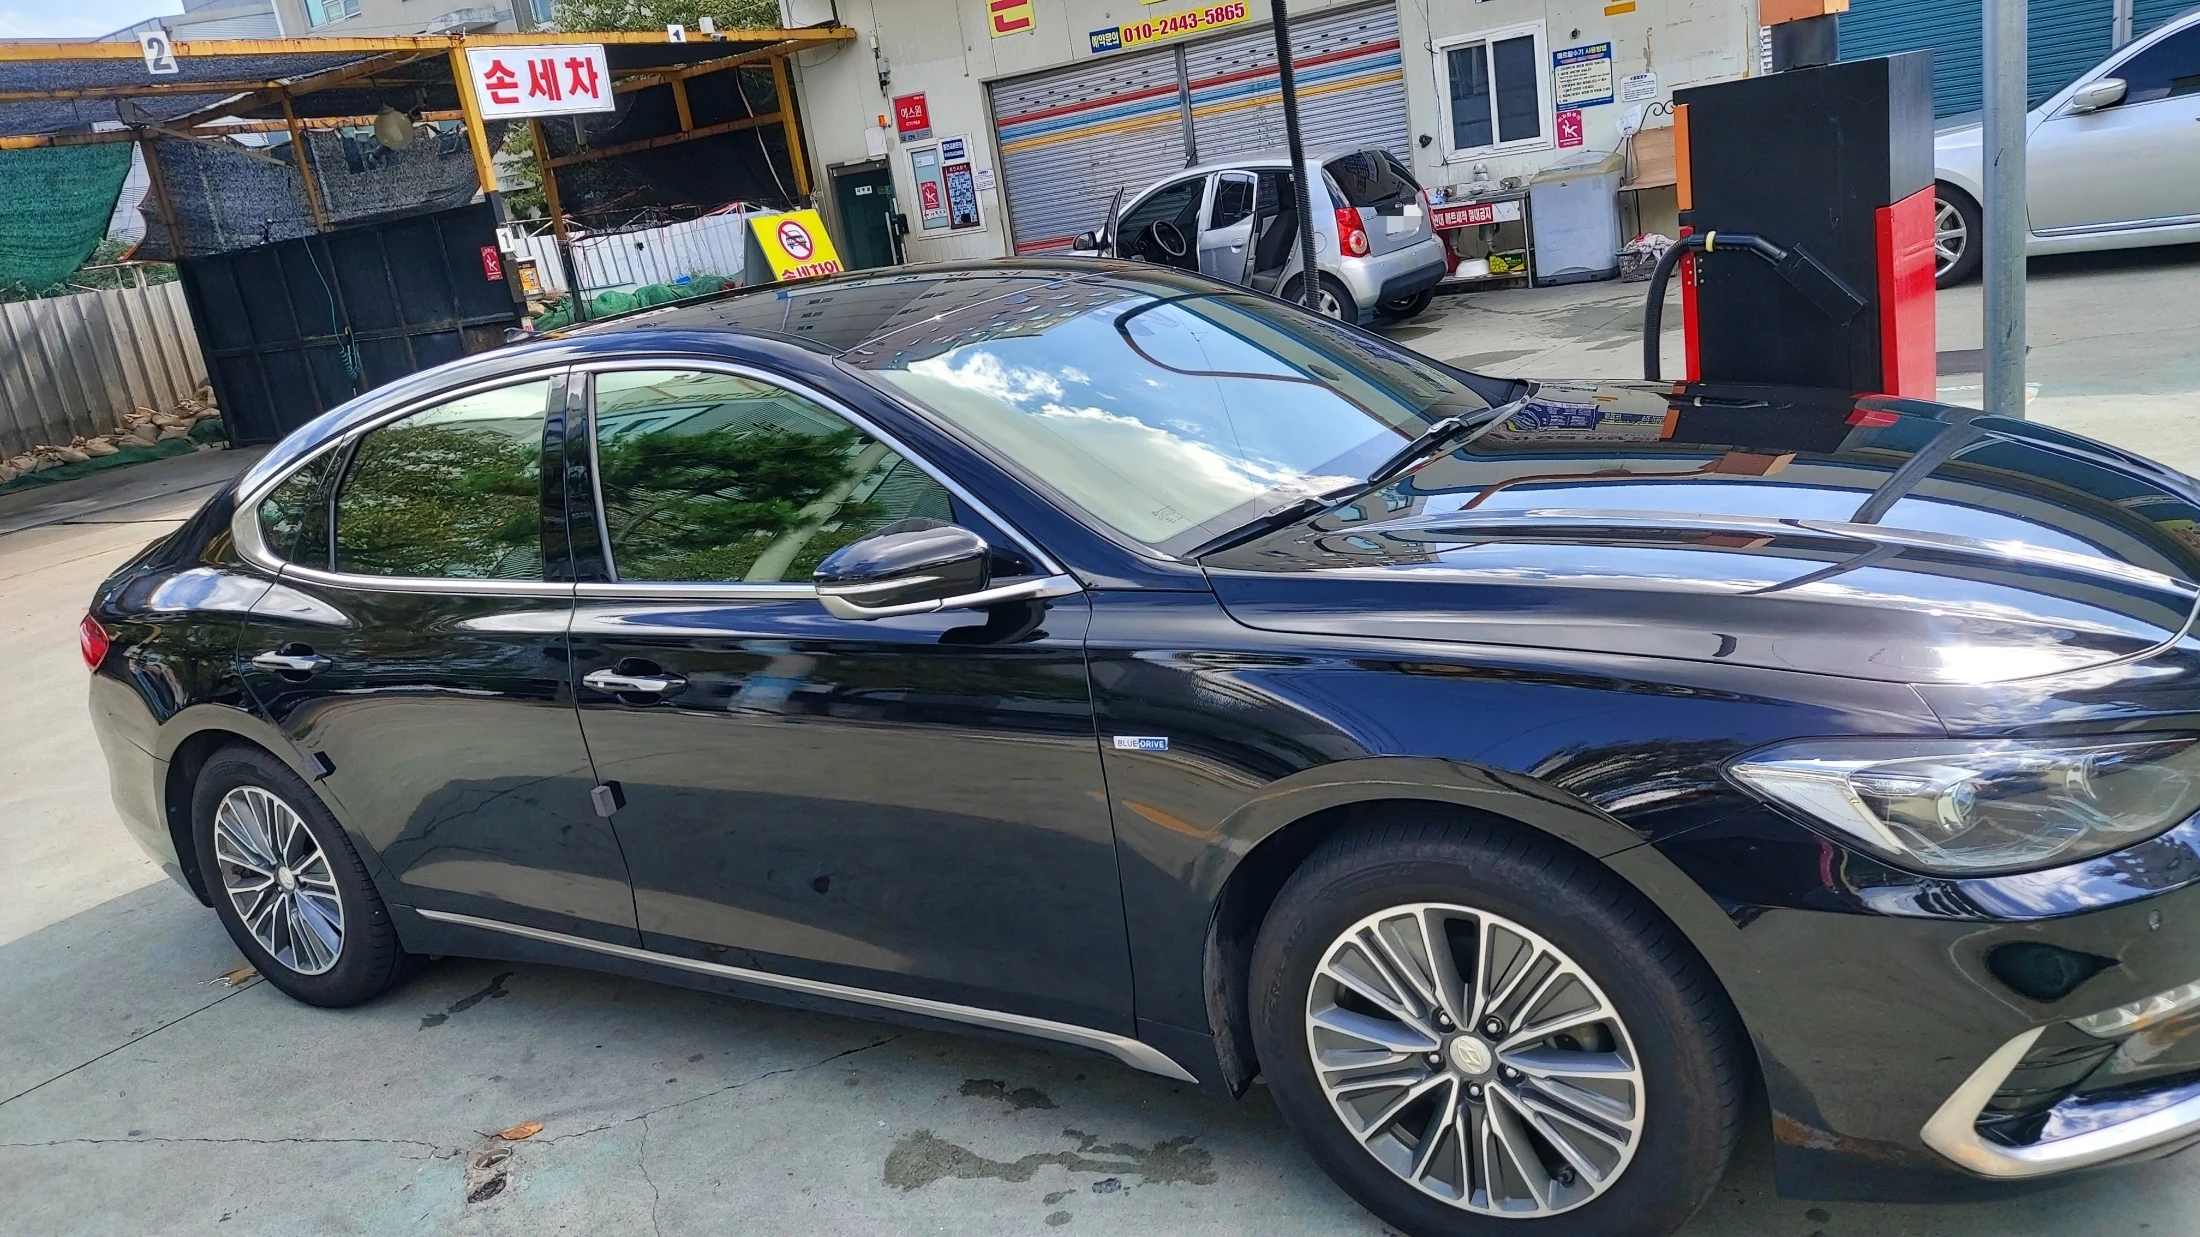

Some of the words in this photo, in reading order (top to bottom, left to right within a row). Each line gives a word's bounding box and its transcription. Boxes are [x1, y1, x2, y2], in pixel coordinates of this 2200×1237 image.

[1092, 33, 1119, 48] 예약문의
[1123, 3, 1245, 43] 010-2443-5865
[673, 30, 681, 41] 1
[147, 37, 172, 70] 2
[483, 57, 599, 104] 손세차
[901, 105, 922, 119] 에스원
[502, 231, 511, 249] 1
[1140, 740, 1165, 749] DRIVE
